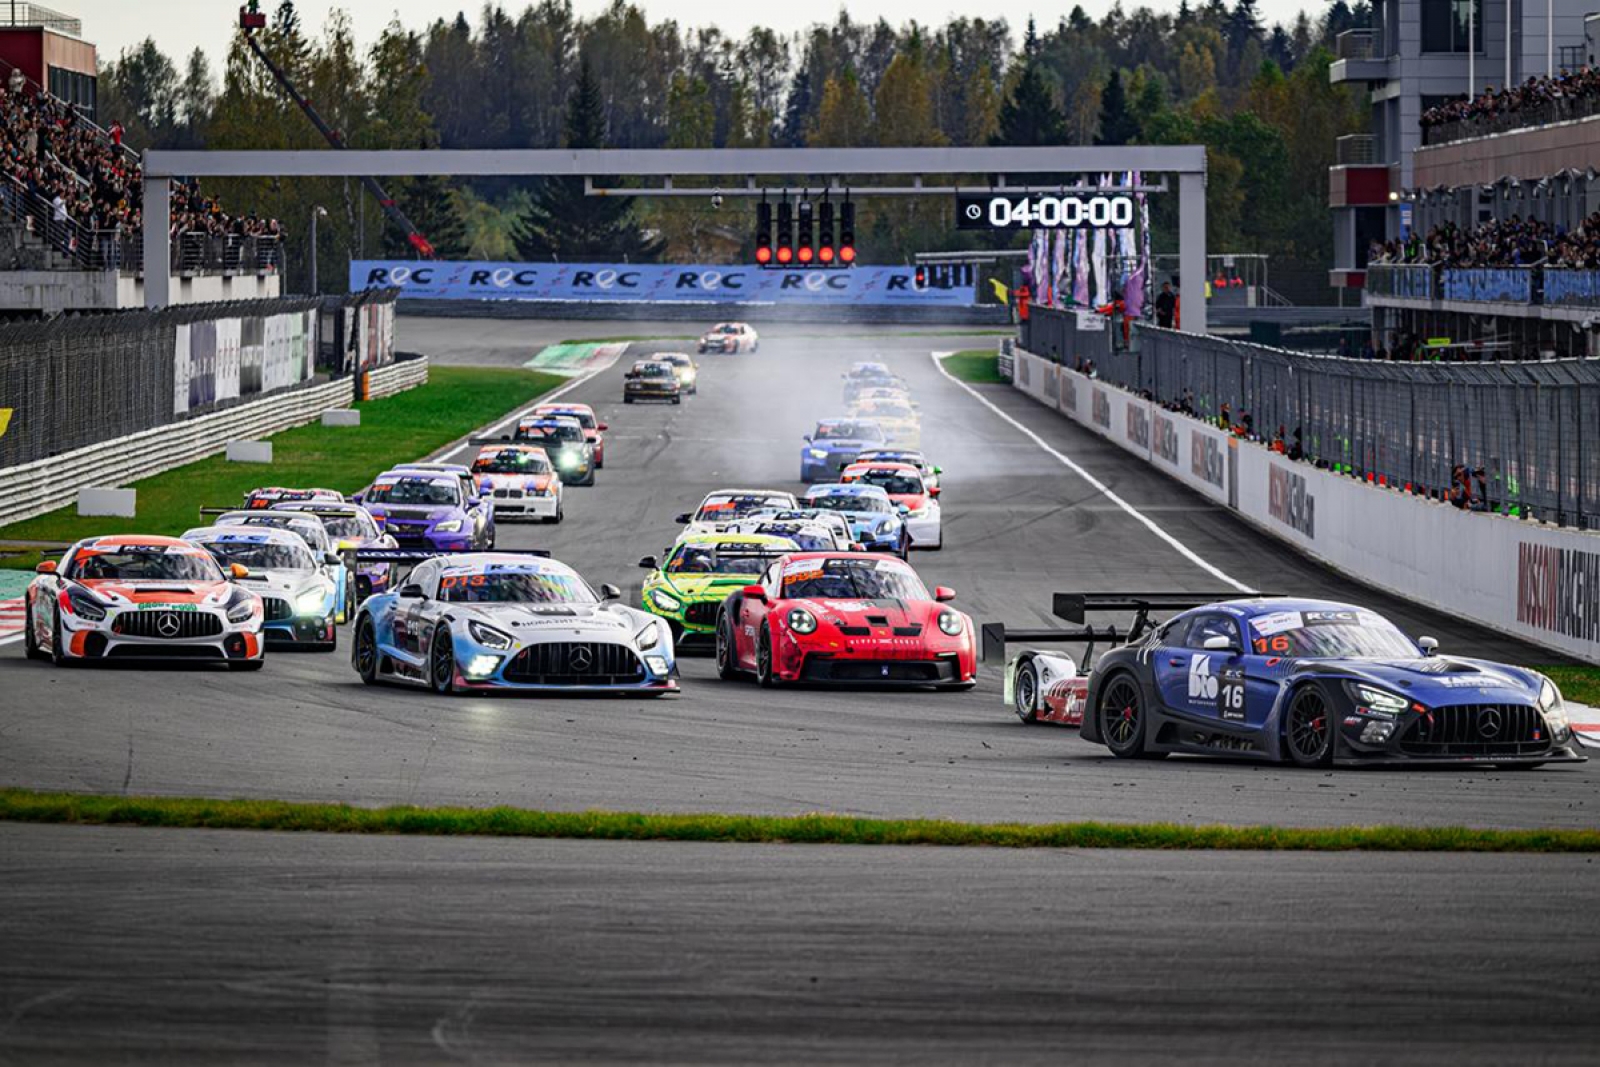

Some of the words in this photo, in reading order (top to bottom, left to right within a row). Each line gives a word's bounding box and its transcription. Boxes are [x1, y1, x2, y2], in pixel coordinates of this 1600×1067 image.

[989, 197, 1133, 227] 04:00:00
[1254, 635, 1289, 653] 16
[1221, 684, 1244, 709] 16
